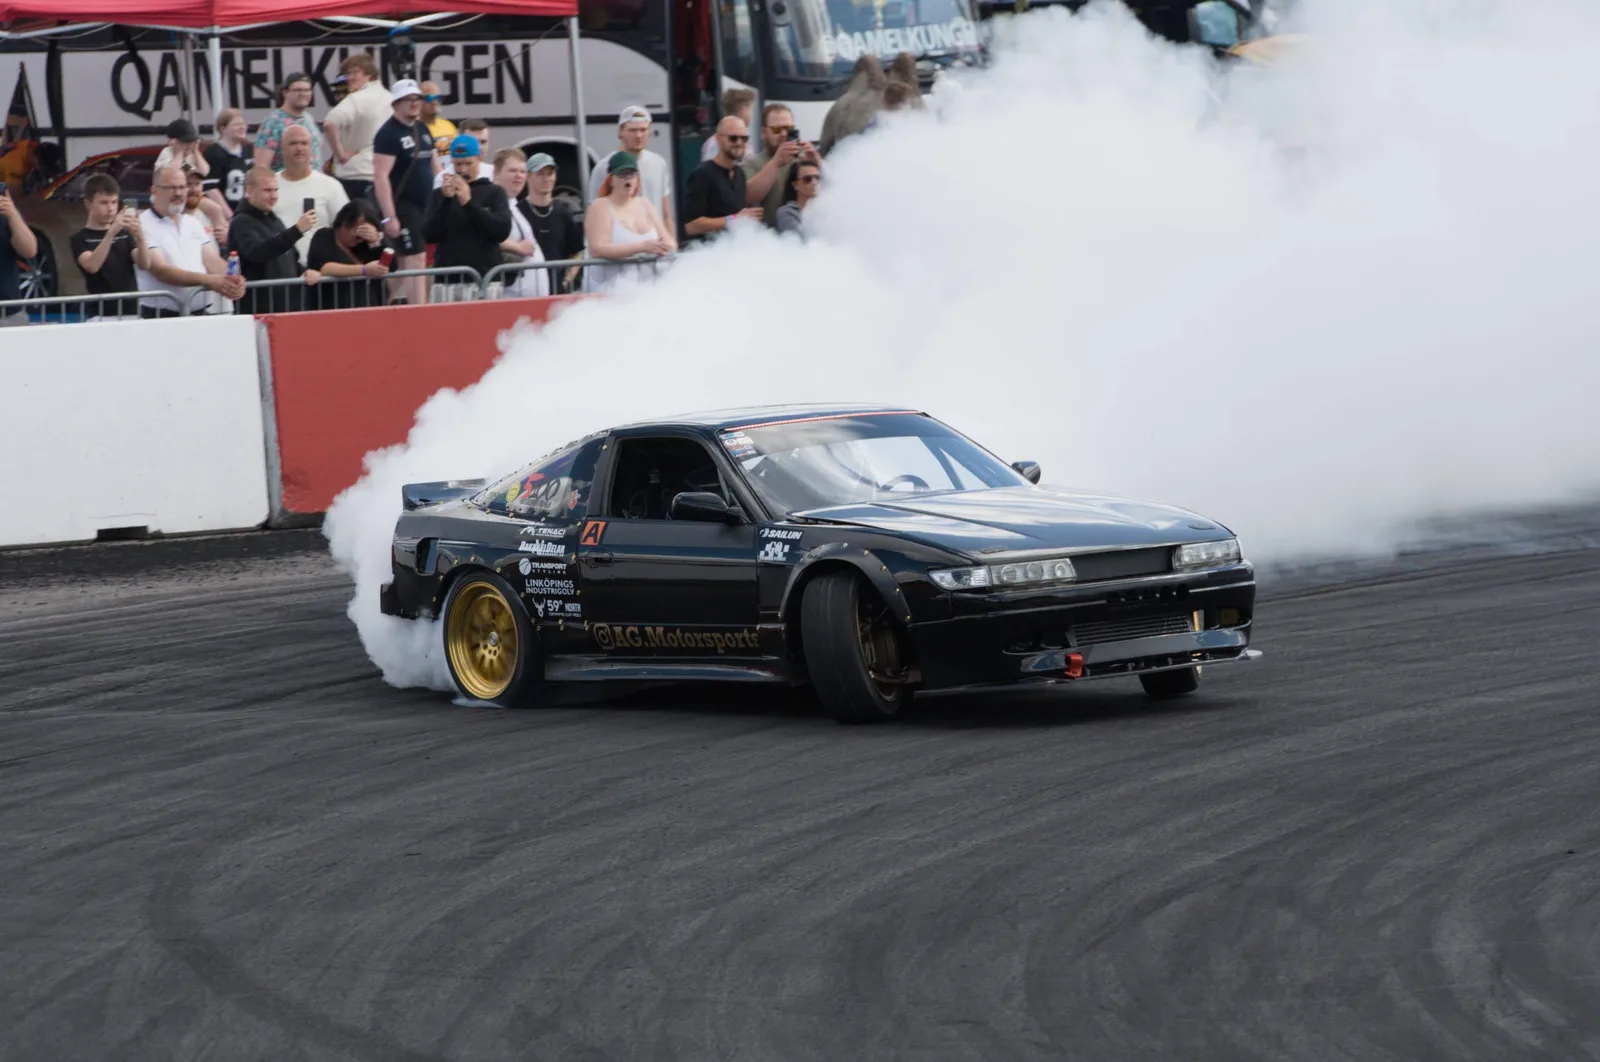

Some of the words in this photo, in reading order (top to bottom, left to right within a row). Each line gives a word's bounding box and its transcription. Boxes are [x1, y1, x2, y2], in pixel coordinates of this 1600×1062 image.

[111, 43, 532, 121] QAMELKNGEN
[583, 522, 601, 544] A
[768, 529, 803, 540] SAILUN
[525, 577, 574, 588] LINKÖPINGS
[525, 587, 575, 595] INDUSTRIGOLV
